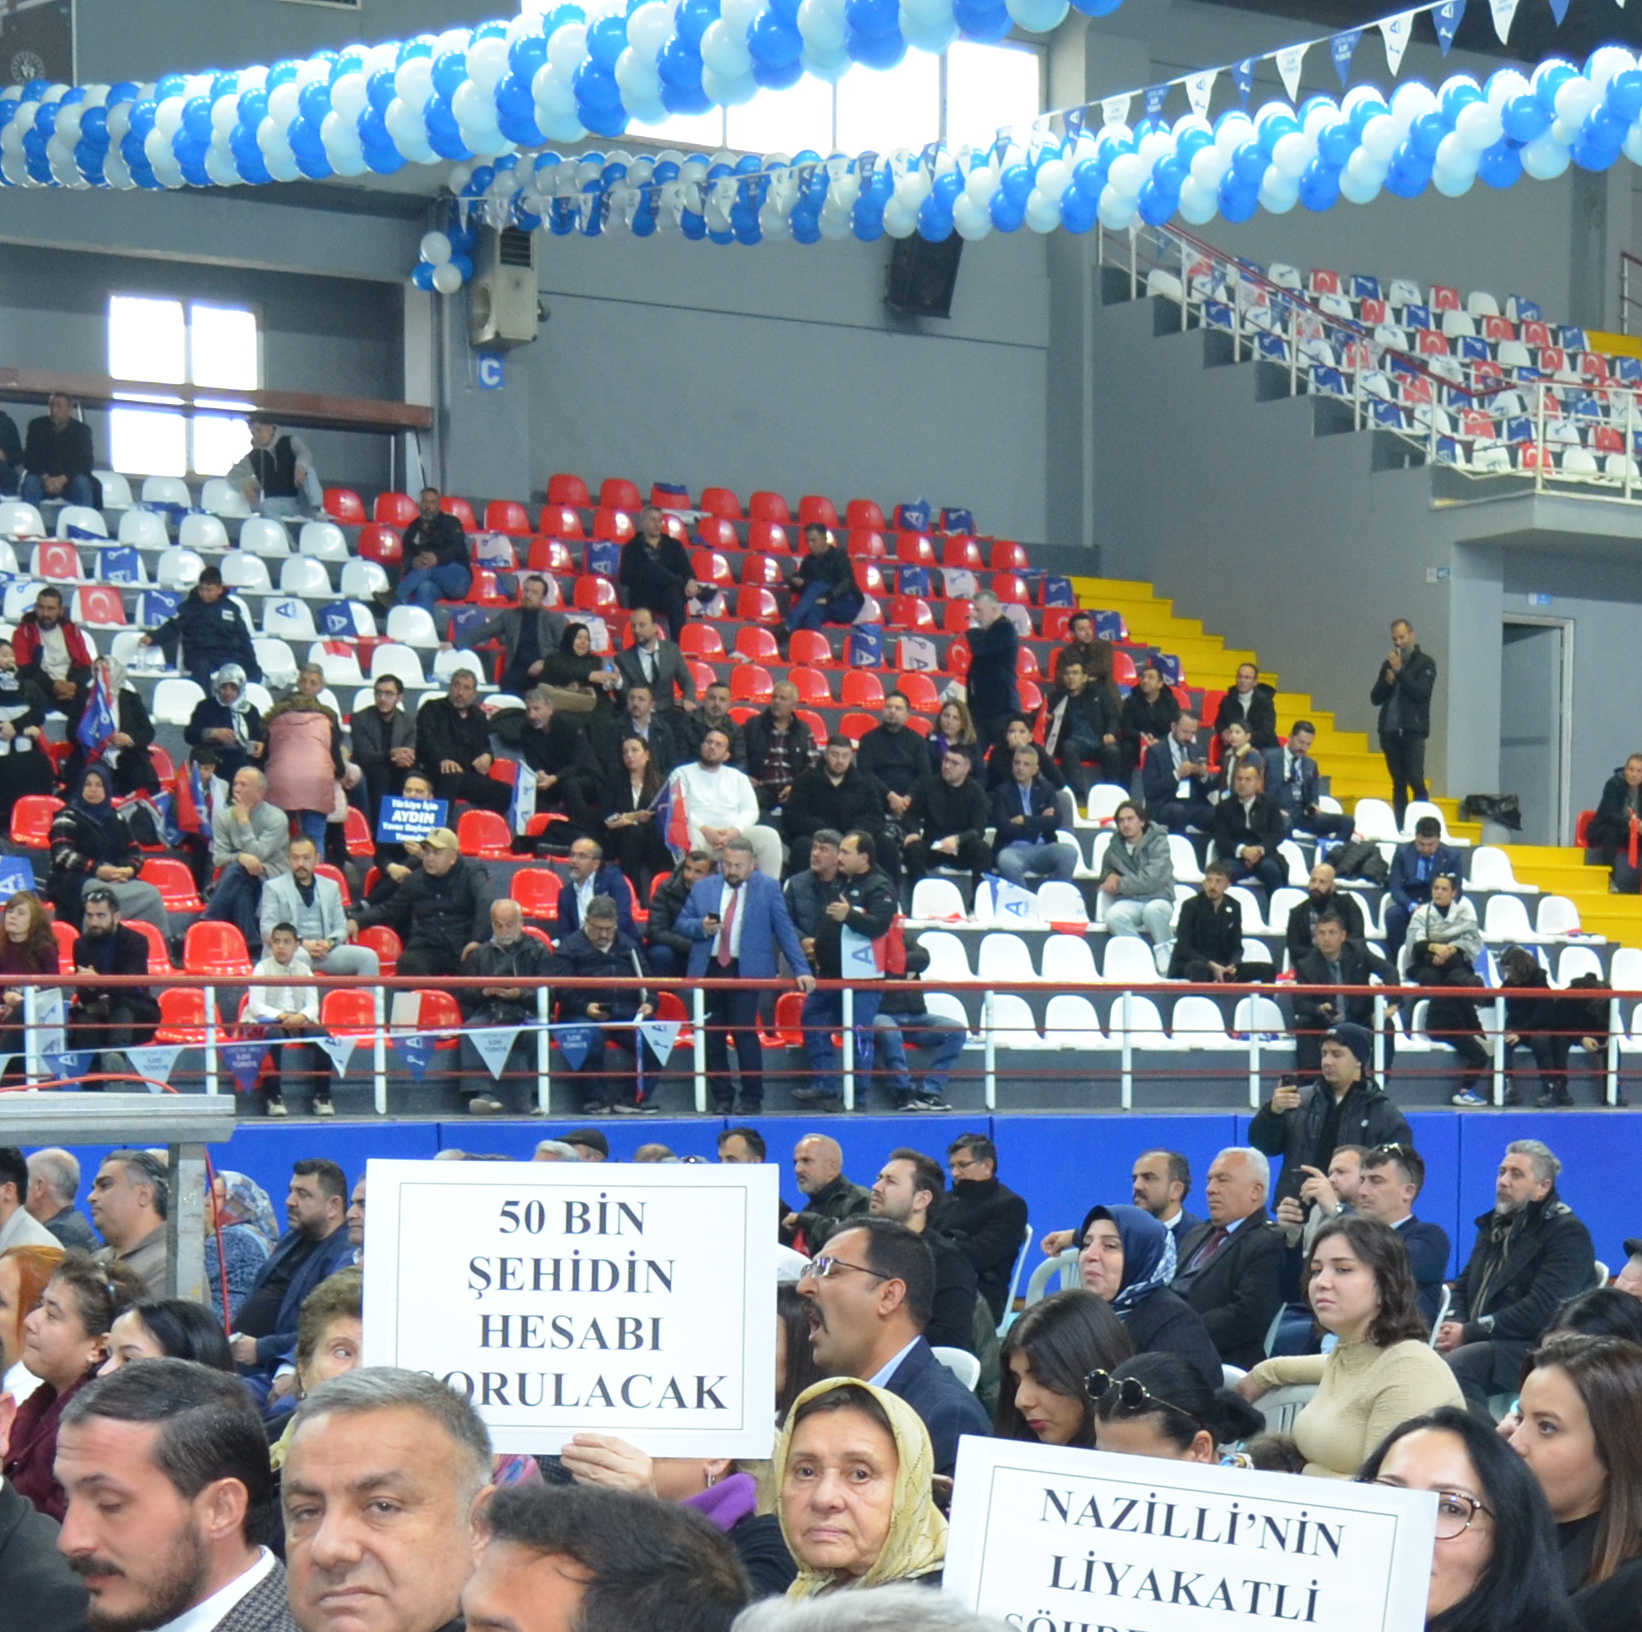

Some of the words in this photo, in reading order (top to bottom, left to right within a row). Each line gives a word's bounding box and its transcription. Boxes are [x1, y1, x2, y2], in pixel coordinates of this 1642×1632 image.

[481, 357, 500, 386] C
[391, 798, 422, 810] Türkiye
[391, 811, 436, 824] AYDIN
[498, 1198, 545, 1235] 50
[563, 1191, 647, 1236] BİN
[467, 1249, 676, 1299] ŞEHİDİN
[478, 1313, 664, 1352] HESABI
[419, 1368, 728, 1410] ORULACAK
[1040, 1488, 1346, 1560] NAZİLLİ’NİN
[1048, 1549, 1323, 1624] LİYAKATLİ
